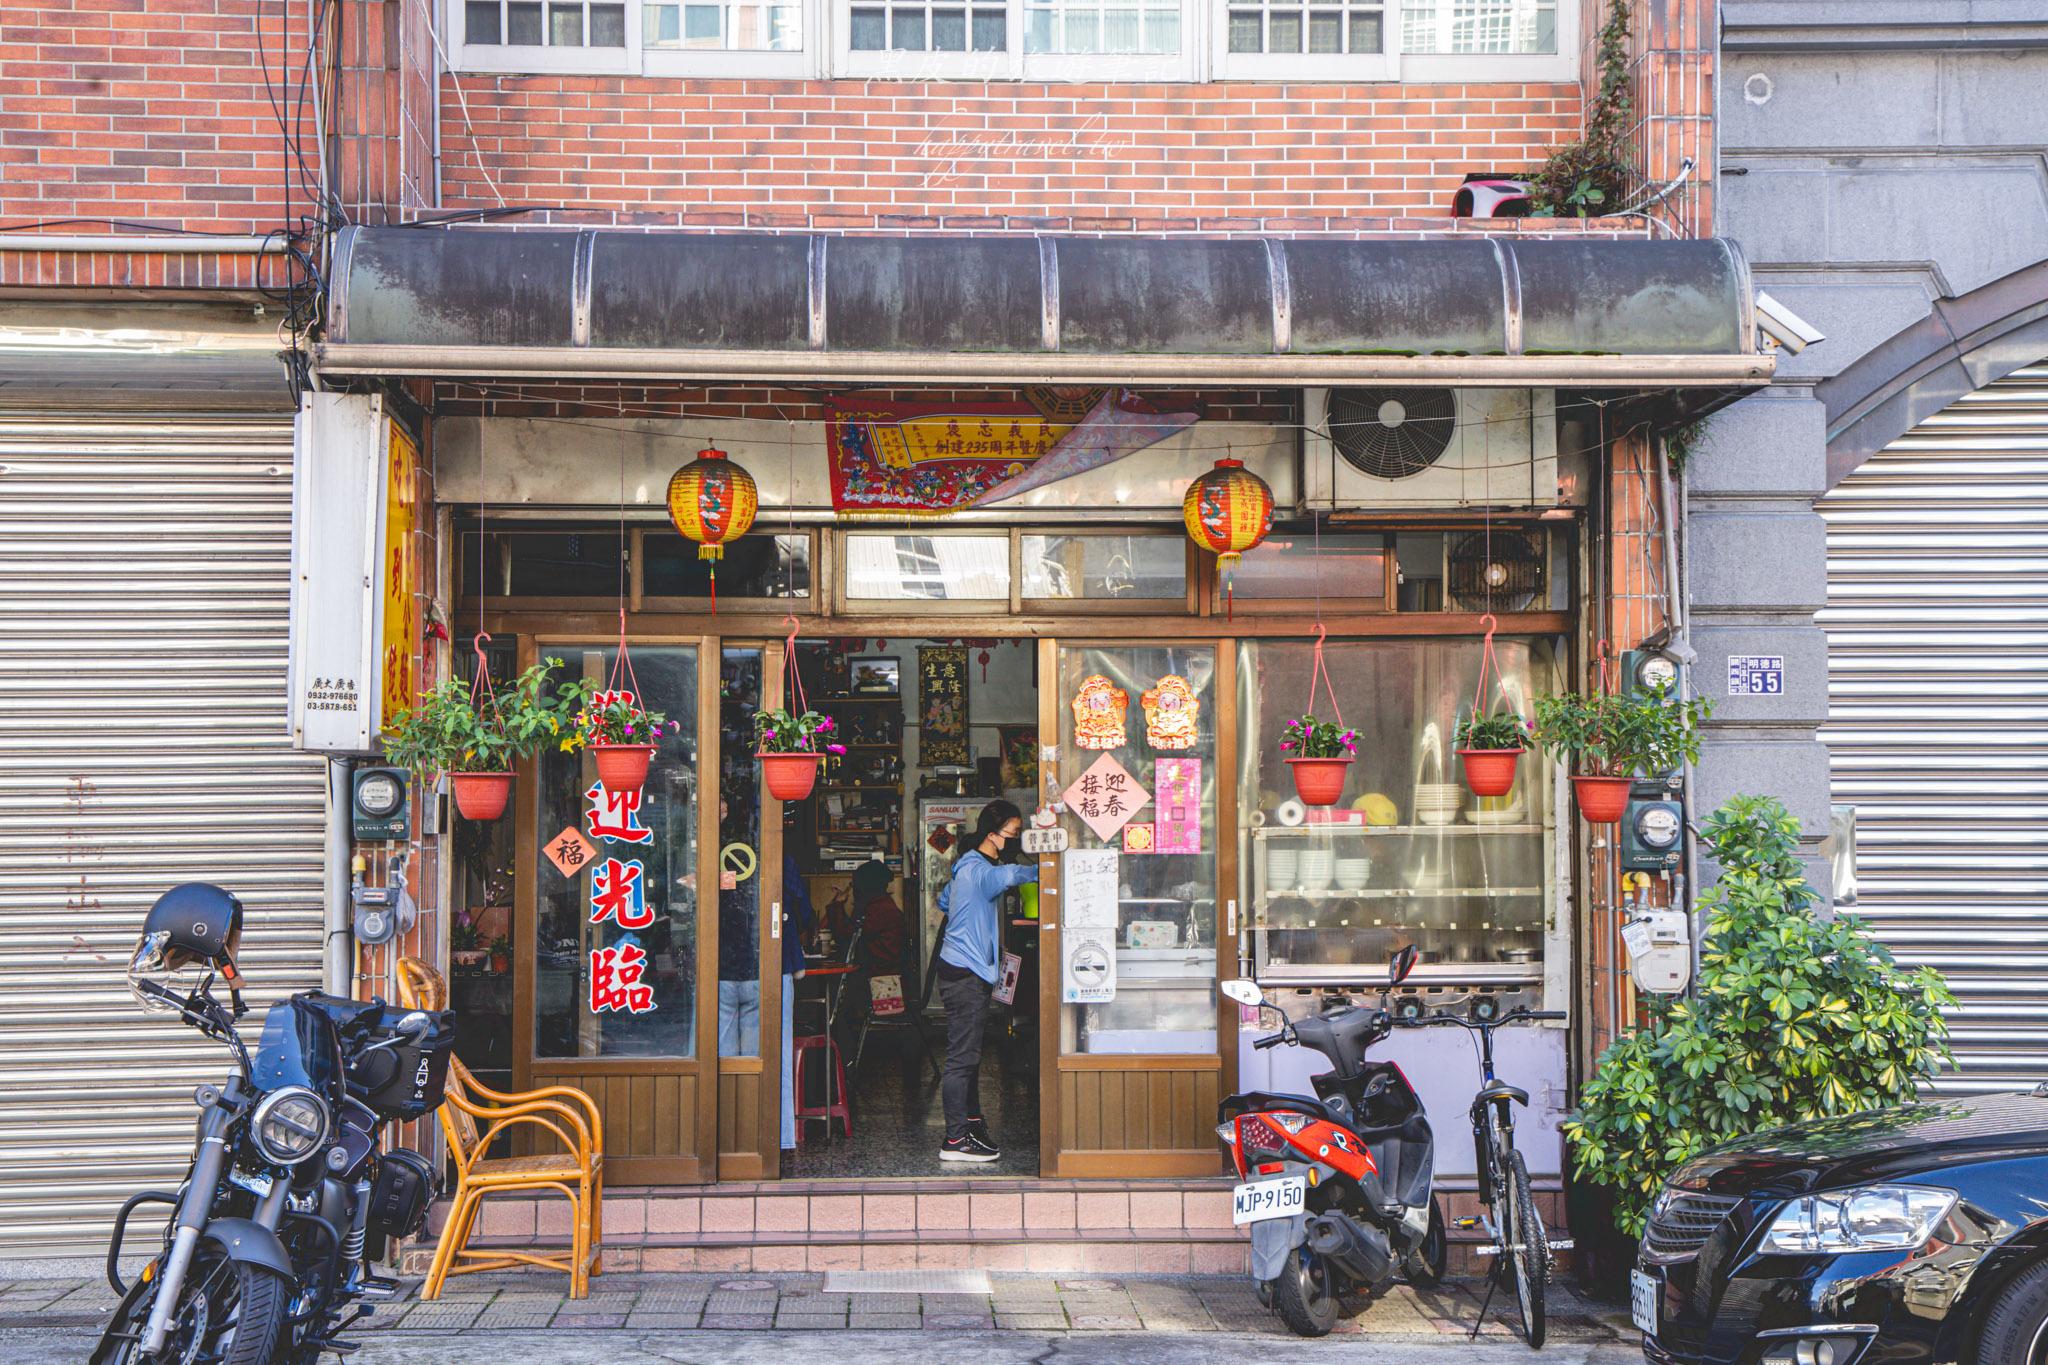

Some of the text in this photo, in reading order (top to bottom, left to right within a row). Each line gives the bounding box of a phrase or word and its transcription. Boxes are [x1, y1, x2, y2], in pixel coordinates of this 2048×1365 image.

[1749, 659, 1781, 669] 明德路
[1751, 672, 1778, 692] 55
[928, 806, 960, 814] SANLUX
[1029, 831, 1062, 844] 營業中
[556, 838, 584, 865] 福
